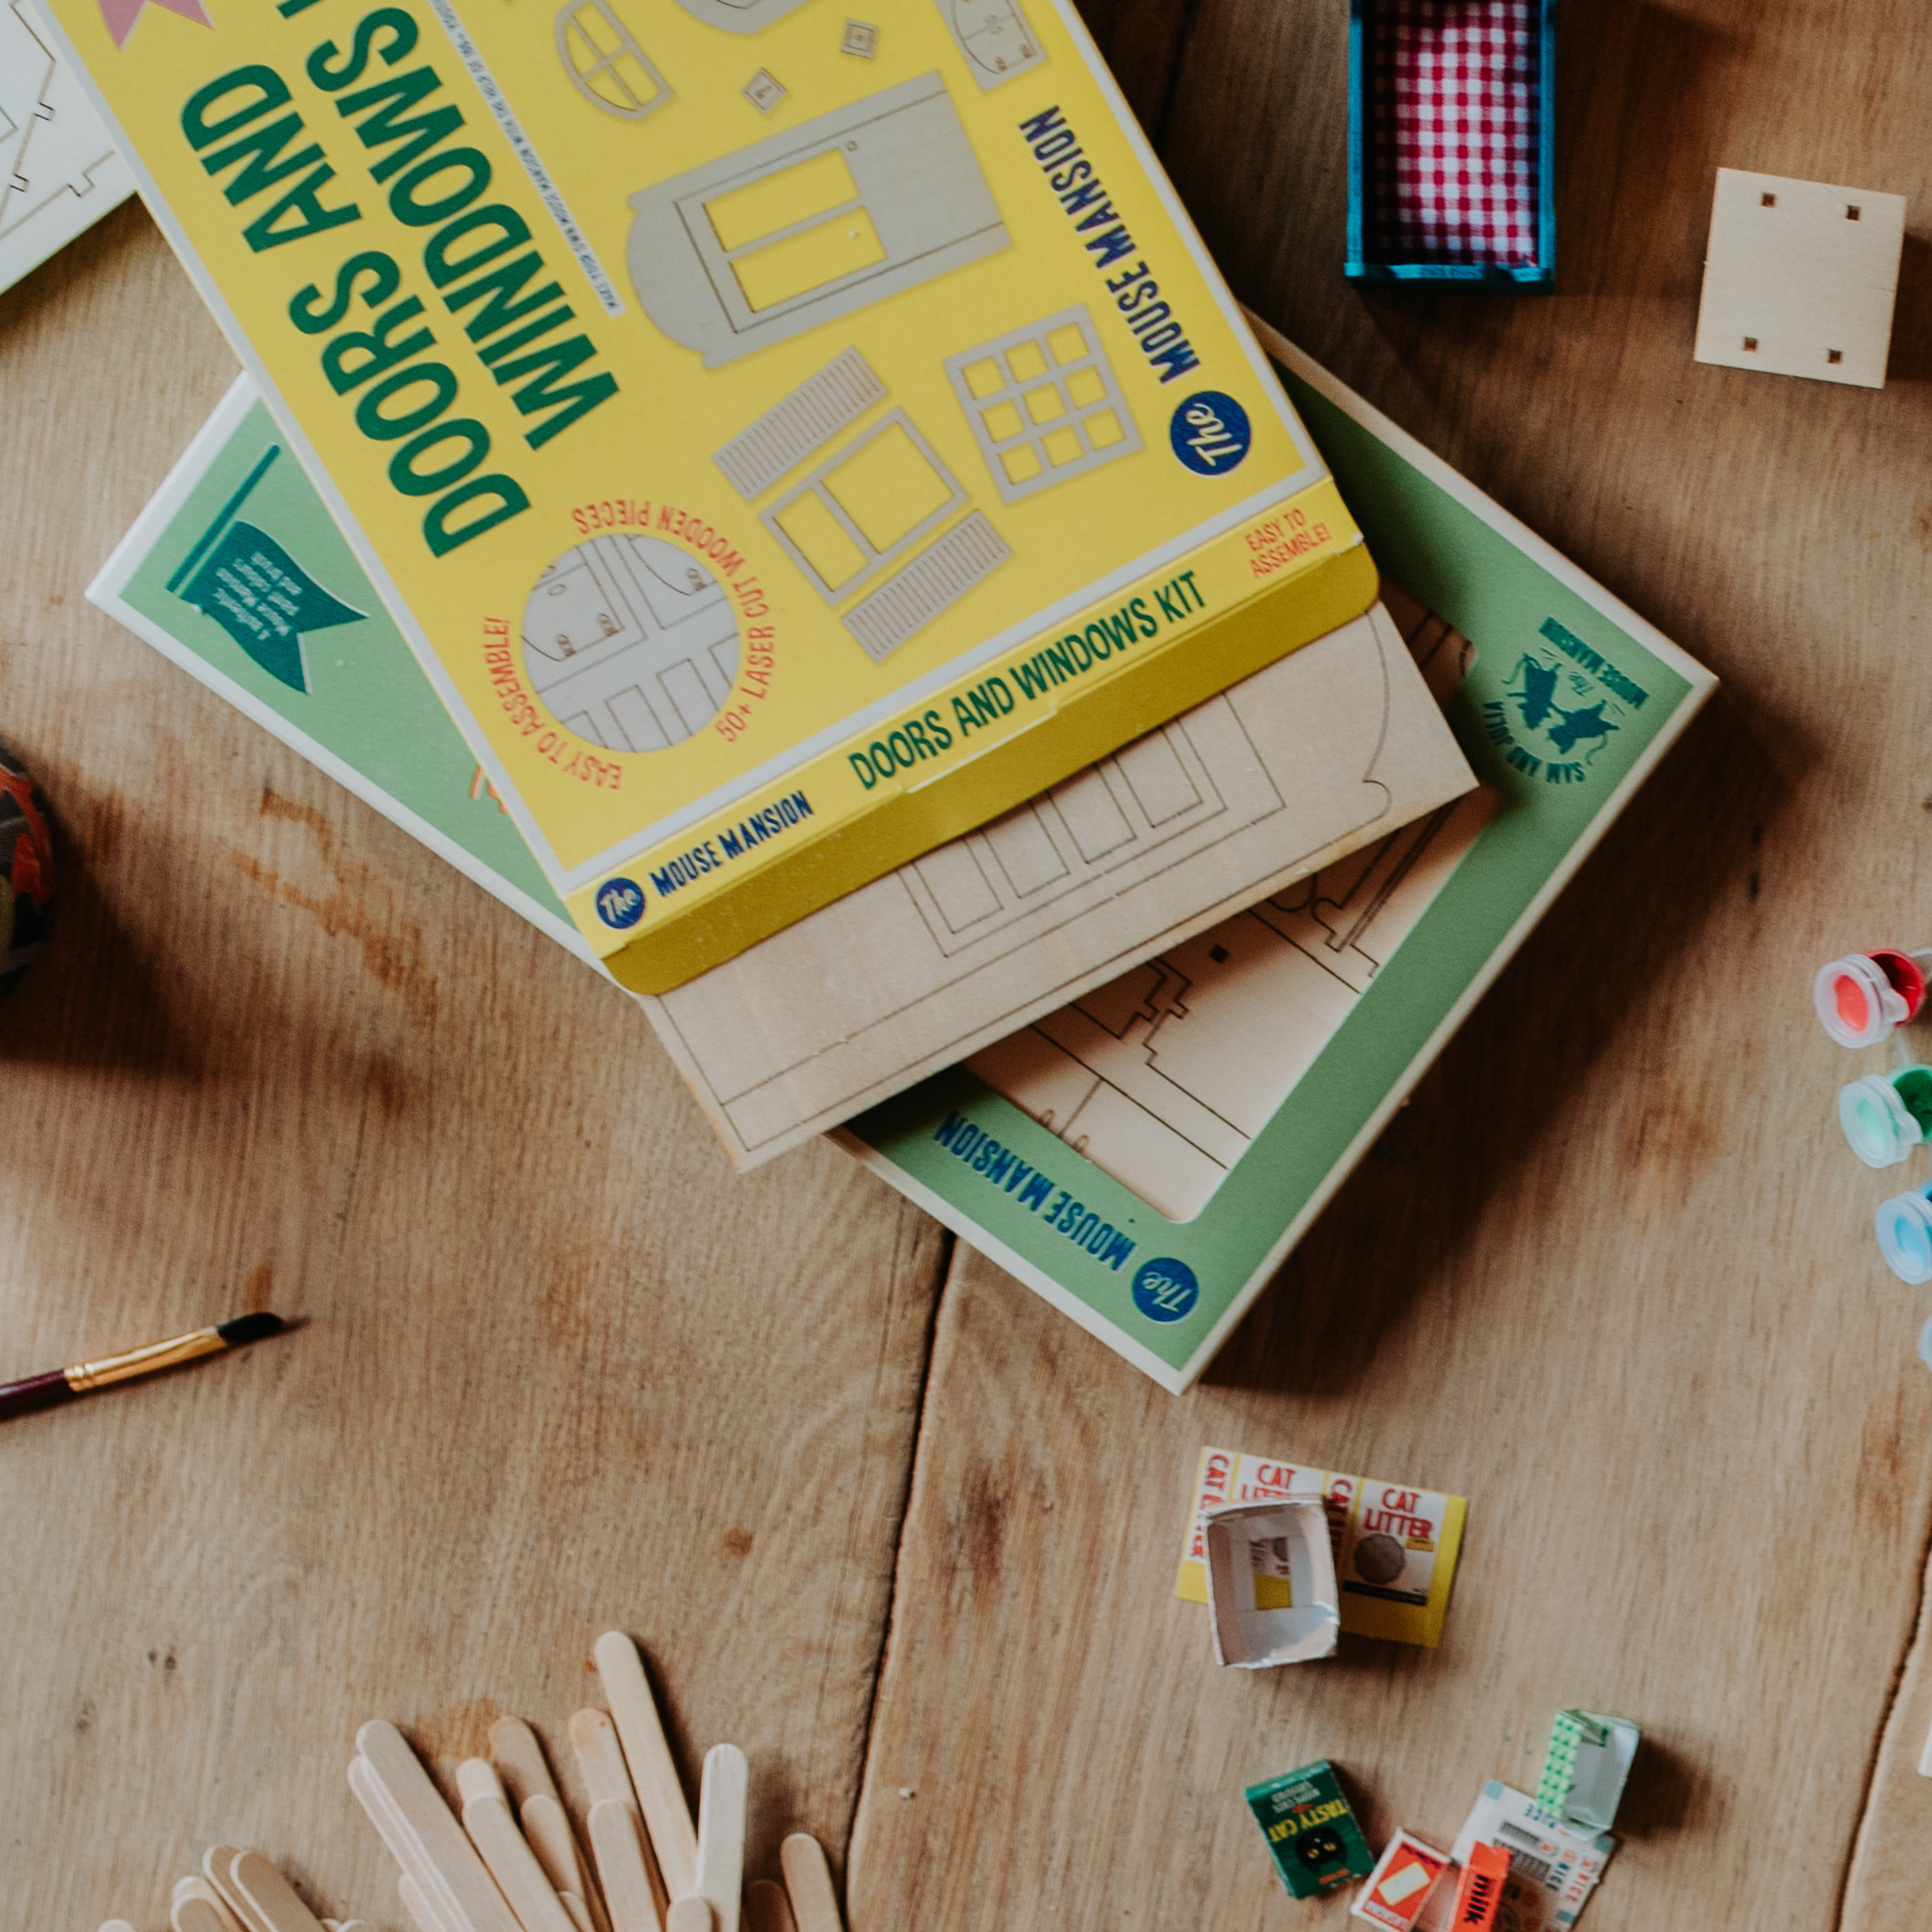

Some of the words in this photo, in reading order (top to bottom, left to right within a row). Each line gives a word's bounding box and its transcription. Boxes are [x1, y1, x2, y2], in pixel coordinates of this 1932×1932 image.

[180, 64, 362, 254] AND
[1018, 105, 1137, 270] MANSION
[306, 7, 620, 451] WINDOWS
[1106, 260, 1201, 385] MOUSE
[289, 251, 531, 558] DOORS
[1186, 402, 1243, 466] The
[572, 500, 651, 534] PIECES
[1244, 518, 1286, 552] EASY
[1284, 508, 1307, 531] TO
[658, 505, 746, 576] WOODEN
[1251, 522, 1333, 579] ASSEMBLE!
[216, 568, 257, 607] Mansion
[733, 577, 771, 619] CUT
[257, 602, 291, 636] Mouse
[483, 617, 538, 737] ASSEMBLE!
[746, 625, 776, 700] LASER
[848, 709, 953, 789] DOORS
[950, 675, 1016, 737] AND
[1009, 598, 1158, 701] WINDOWS
[1152, 571, 1208, 623] KIT
[716, 703, 752, 743] 50+
[536, 731, 568, 764] TO
[564, 753, 623, 791] EASY
[599, 888, 641, 922] The
[649, 841, 722, 897] MOUSE
[717, 790, 814, 859] MANSION
[934, 1112, 1055, 1212] MANSION
[1044, 1191, 1137, 1272] MOUSE
[1143, 1271, 1192, 1313] The
[1205, 1454, 1229, 1491] CAT
[1257, 1464, 1296, 1489] CAT
[1382, 1487, 1420, 1513] CAT
[1364, 1508, 1432, 1539] LITTER
[1268, 1819, 1297, 1842] CAT
[1299, 1799, 1348, 1829] TASTY
